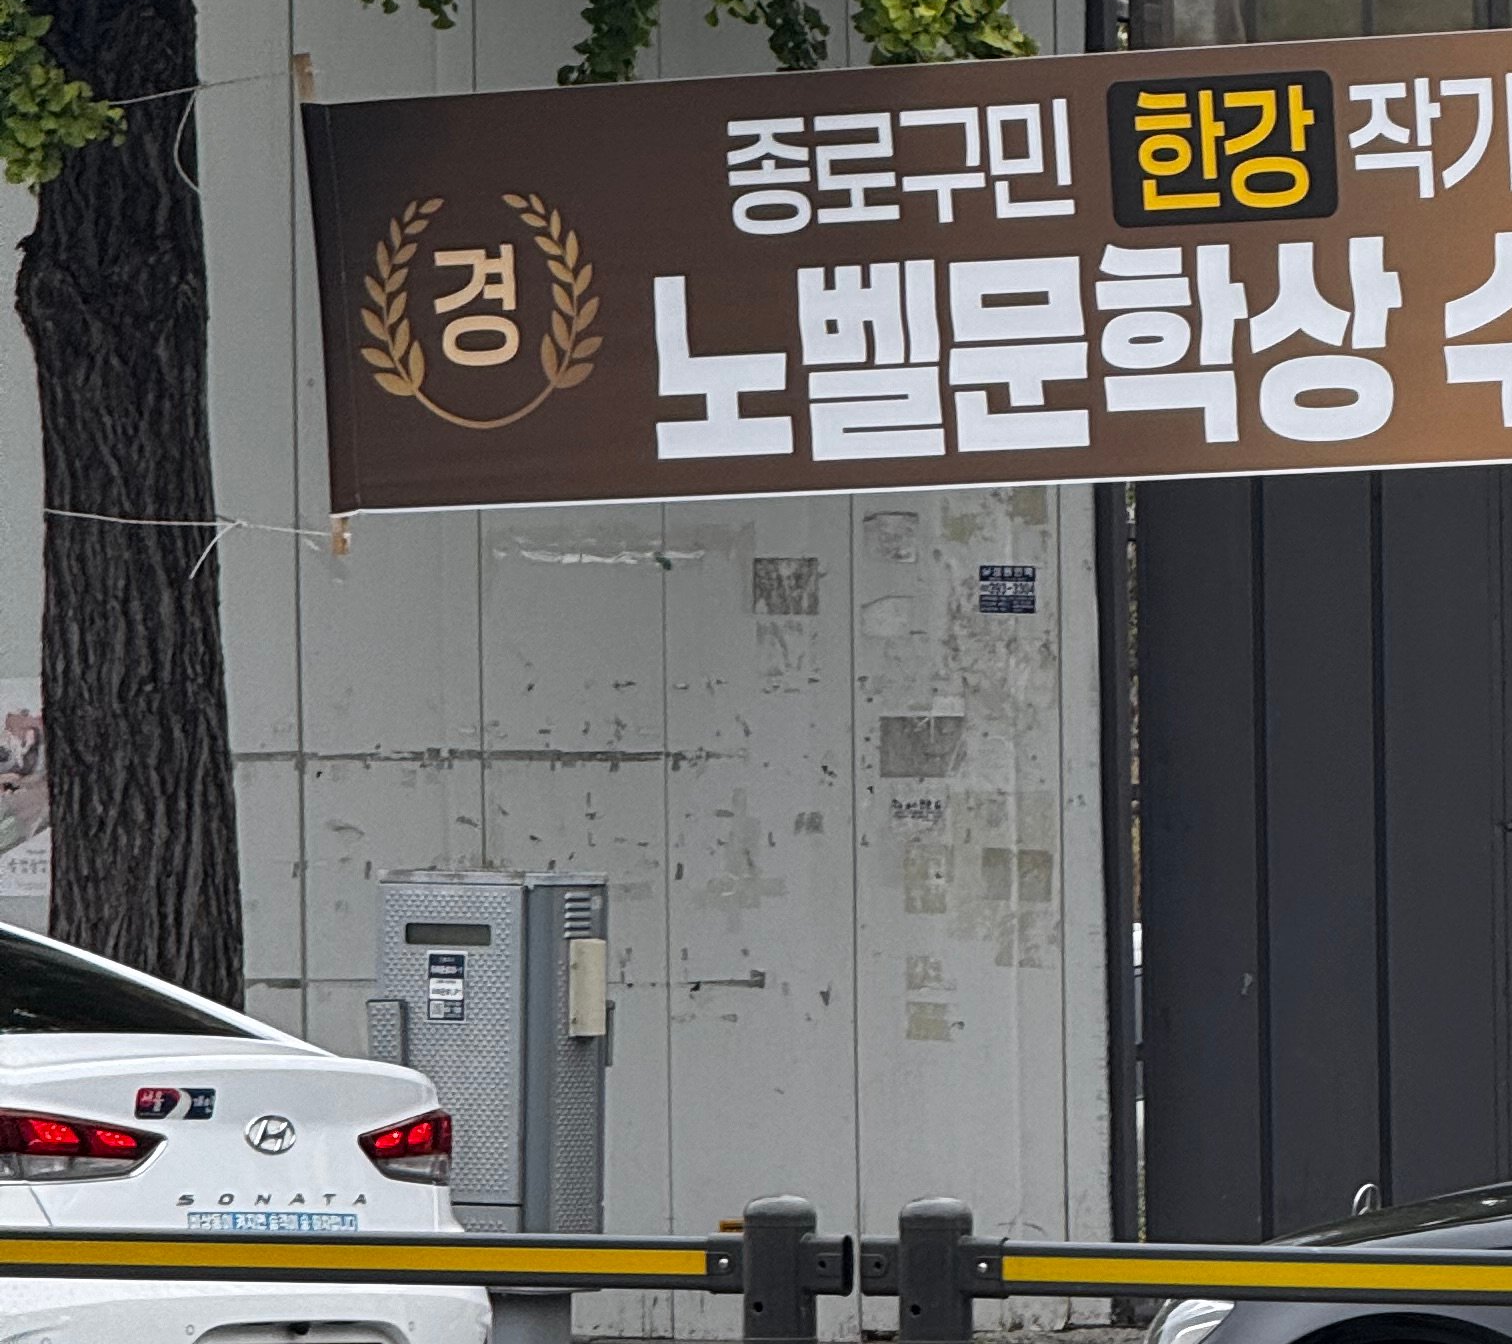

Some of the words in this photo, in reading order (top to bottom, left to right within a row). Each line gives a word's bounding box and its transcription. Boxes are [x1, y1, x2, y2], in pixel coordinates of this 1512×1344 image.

[726, 98, 1076, 236] 종로구민
[1133, 84, 1315, 211] 한강
[433, 243, 521, 368] 경
[653, 236, 1403, 462] 노벨문학상
[176, 1192, 368, 1207] SONATA
